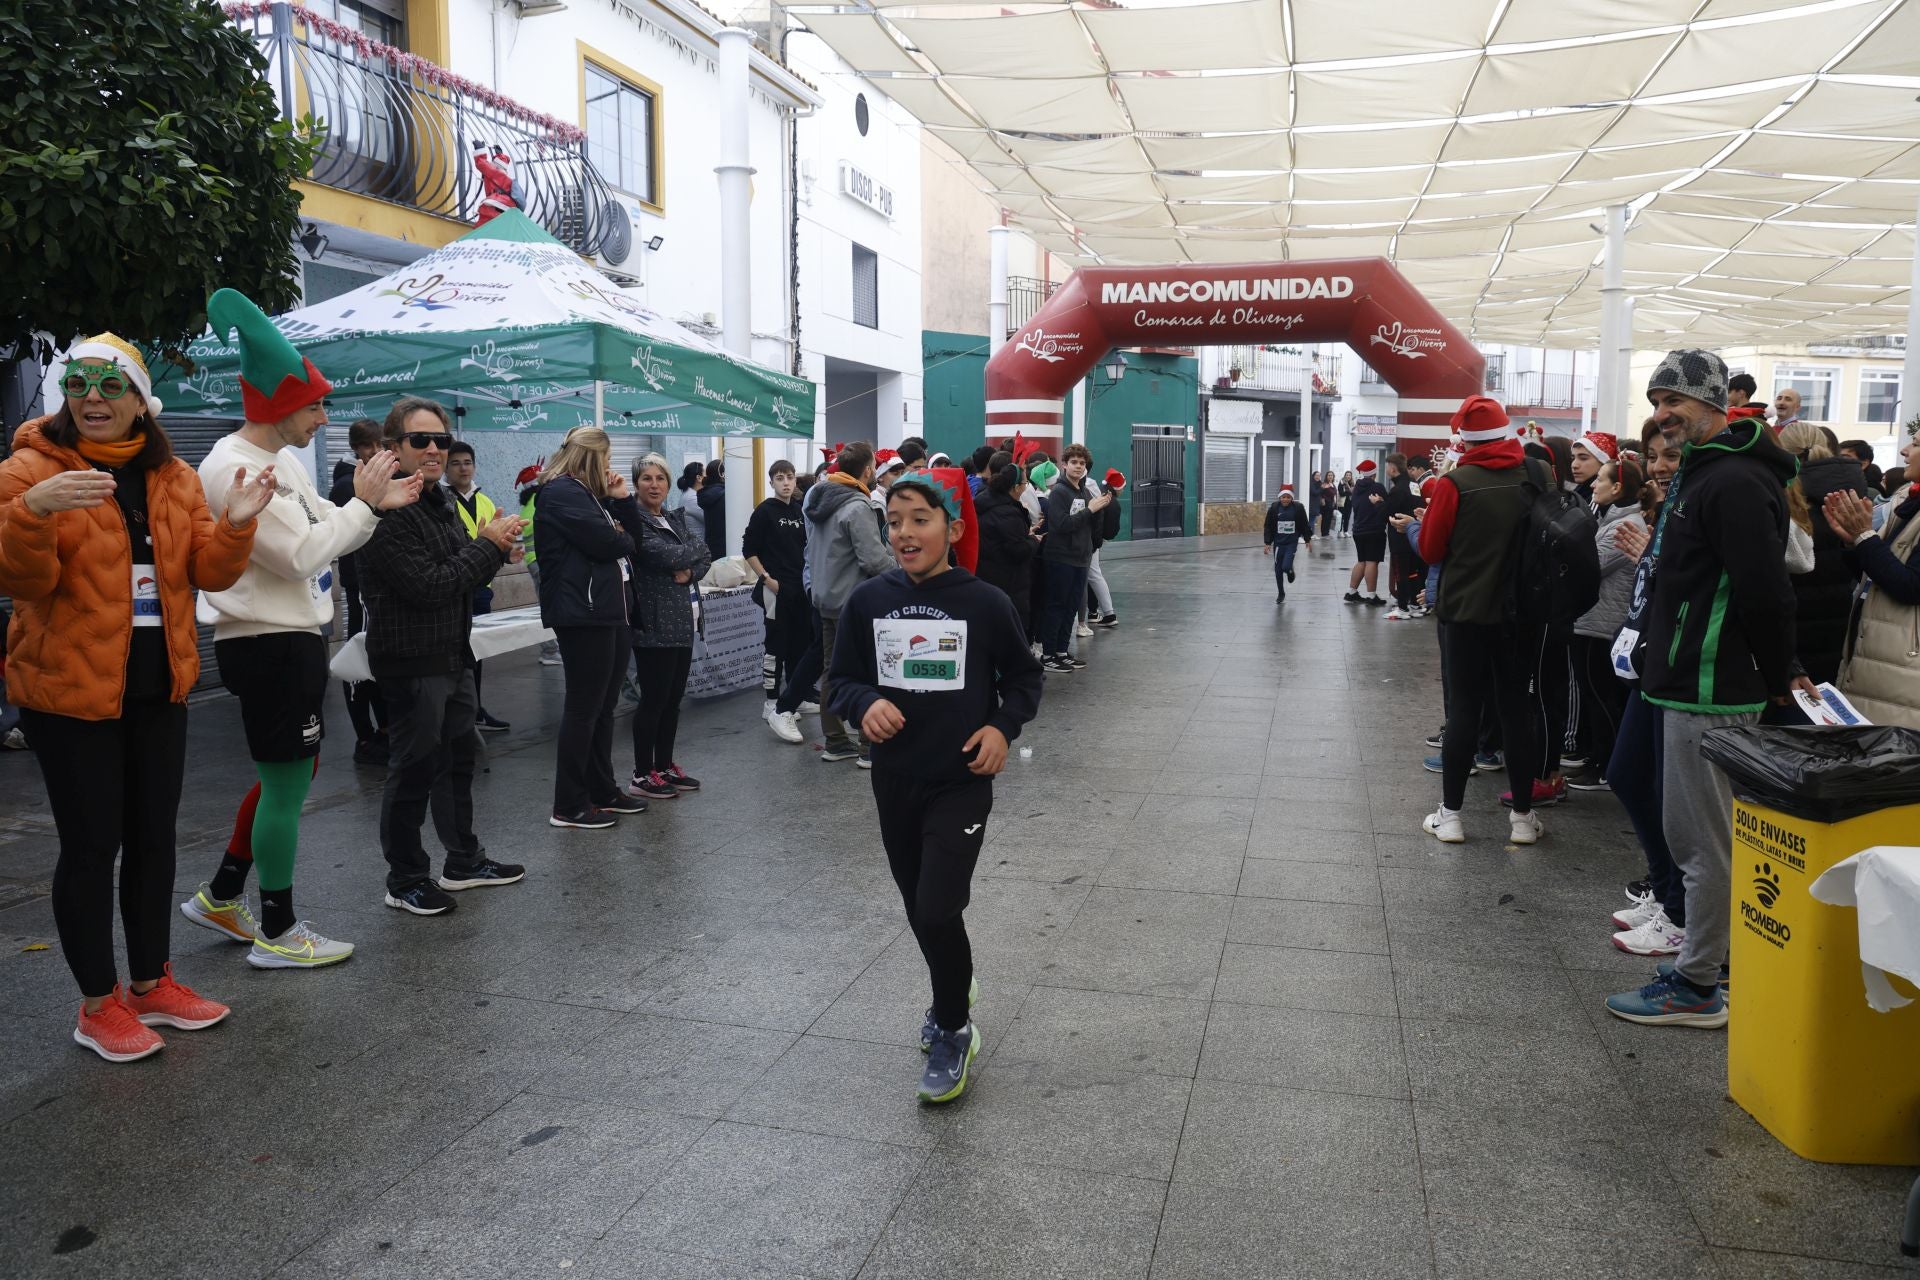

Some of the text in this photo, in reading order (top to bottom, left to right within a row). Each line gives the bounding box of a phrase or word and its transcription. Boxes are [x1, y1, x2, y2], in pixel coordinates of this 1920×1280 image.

[851, 167, 872, 204] DISCO
[879, 185, 893, 216] PUB
[1101, 276, 1354, 305] MANCOMUNIDAD
[1134, 307, 1305, 331] Comarca de Olivenza
[354, 359, 421, 386] Comarca!
[911, 663, 947, 677] 0538
[1735, 827, 1741, 837] DE
[1766, 844, 1782, 859] LATAS
[1736, 808, 1806, 856] SOLO ENVASES
[1741, 900, 1791, 942] PROMEDIO
